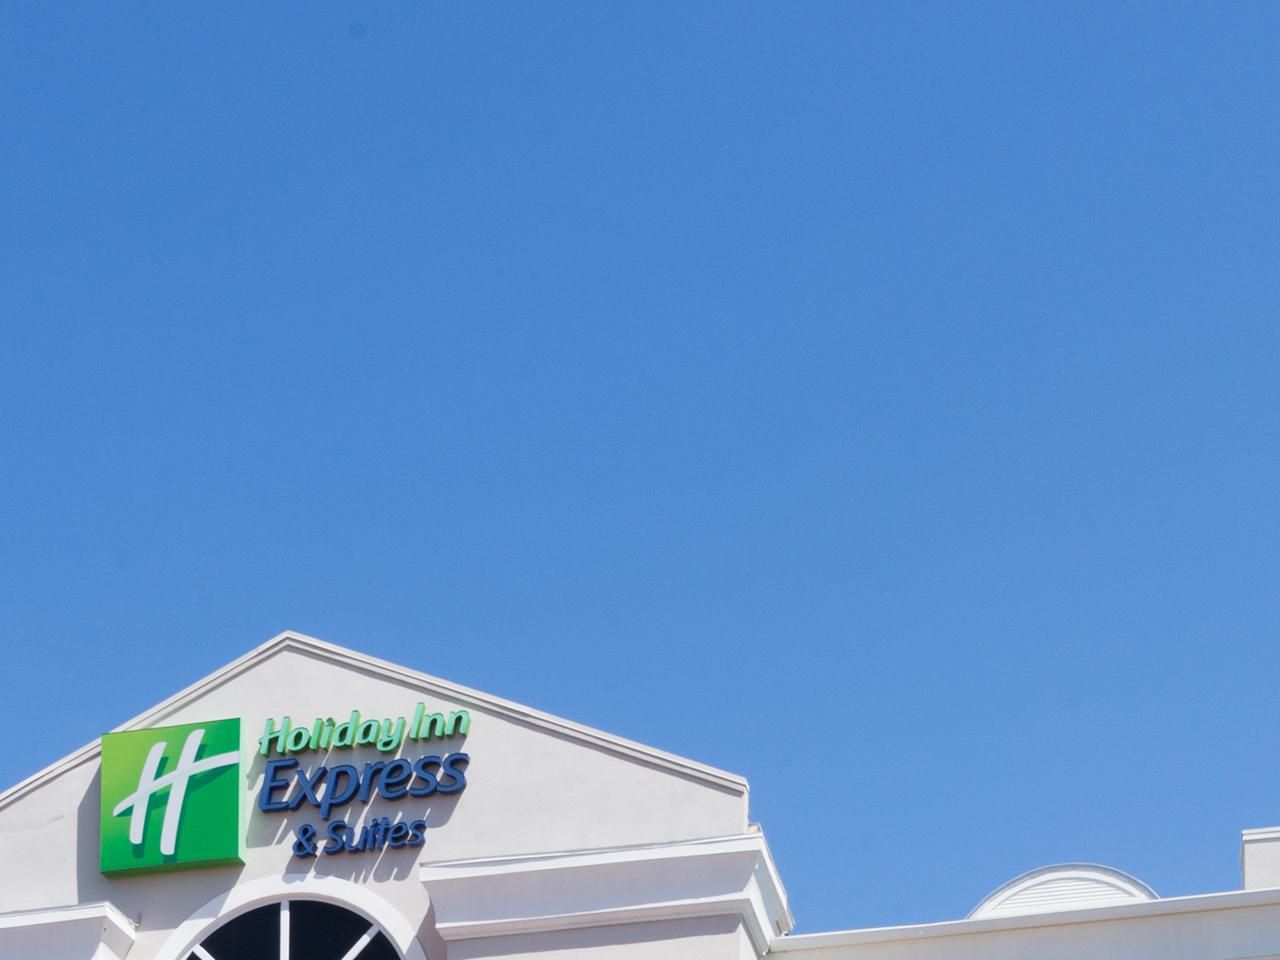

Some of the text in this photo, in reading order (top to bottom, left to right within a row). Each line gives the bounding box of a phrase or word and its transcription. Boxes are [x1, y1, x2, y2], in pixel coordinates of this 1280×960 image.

[258, 702, 470, 757] Holiday Inn
[112, 729, 240, 856] H
[257, 752, 470, 821] Express
[292, 817, 427, 858] & Suites
